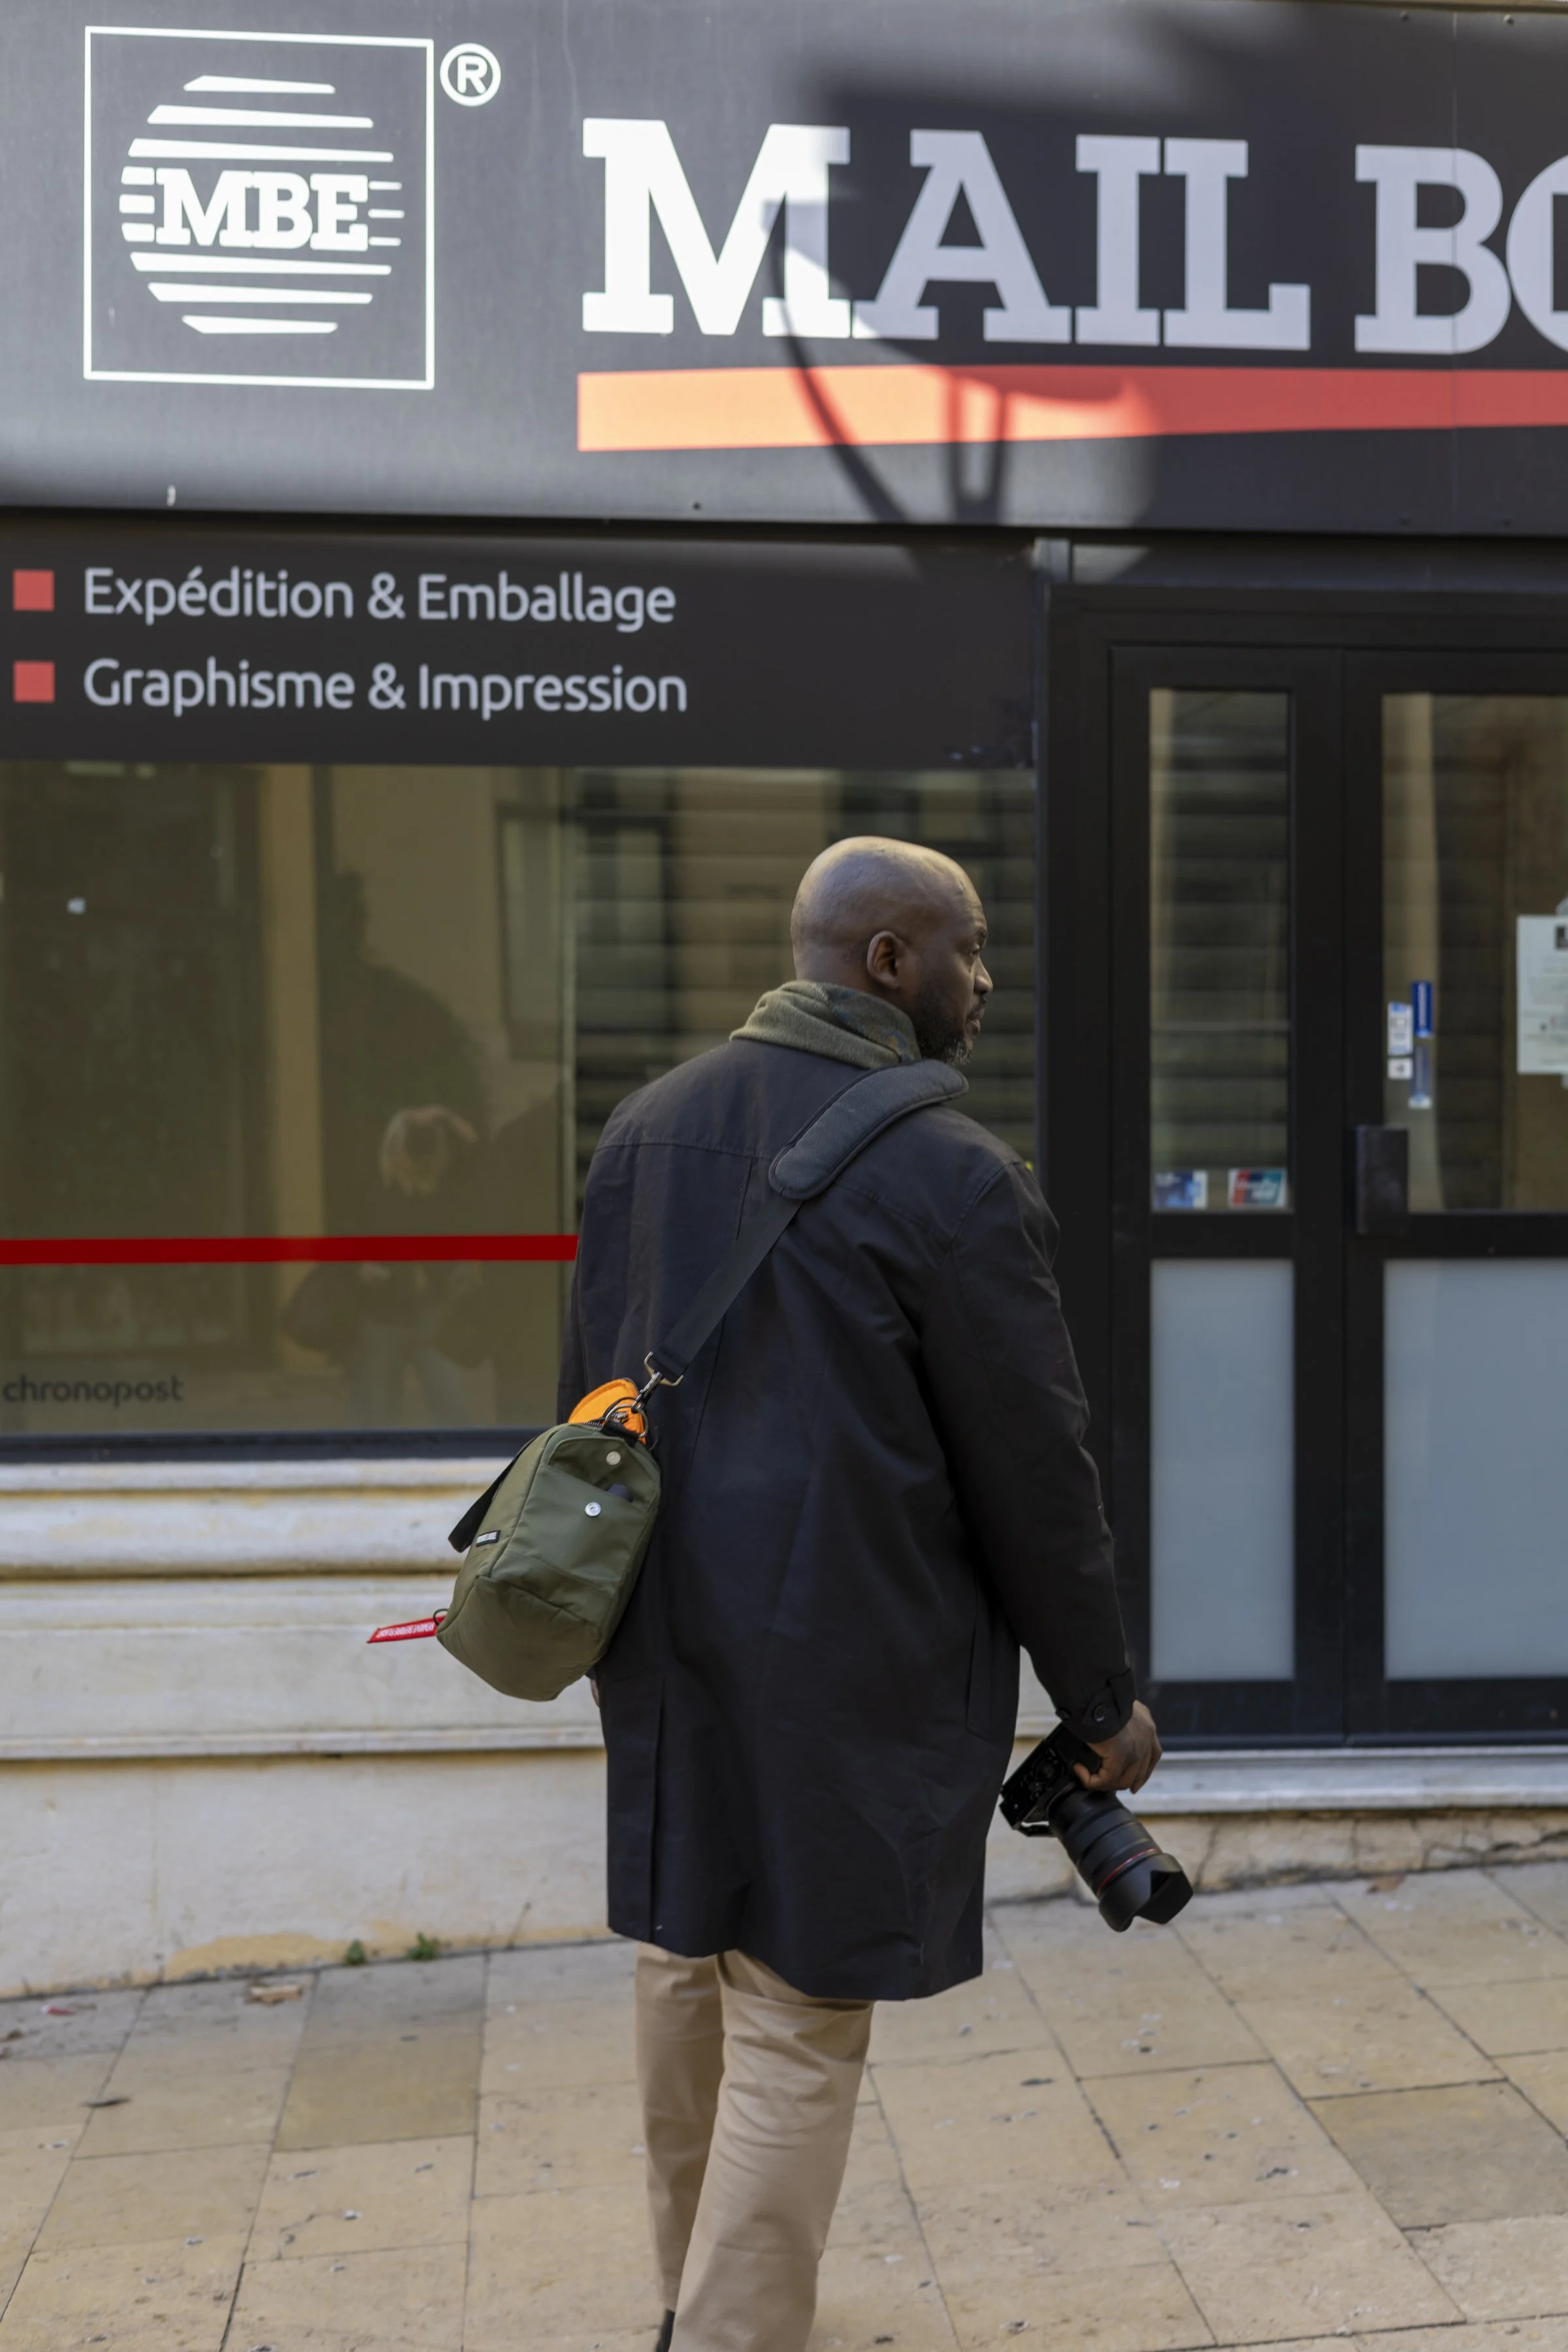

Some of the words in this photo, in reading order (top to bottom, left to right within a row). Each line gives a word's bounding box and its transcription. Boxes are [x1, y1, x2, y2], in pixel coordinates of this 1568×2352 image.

[156, 167, 368, 252] MBE
[582, 118, 1311, 350] MAIL
[85, 566, 353, 625] Expédition
[368, 573, 405, 618] &
[419, 572, 676, 632] Emballage
[84, 657, 355, 716] Graphisme
[368, 663, 405, 709] &
[420, 664, 687, 720] Impression
[3, 1374, 185, 1409] chronopost
